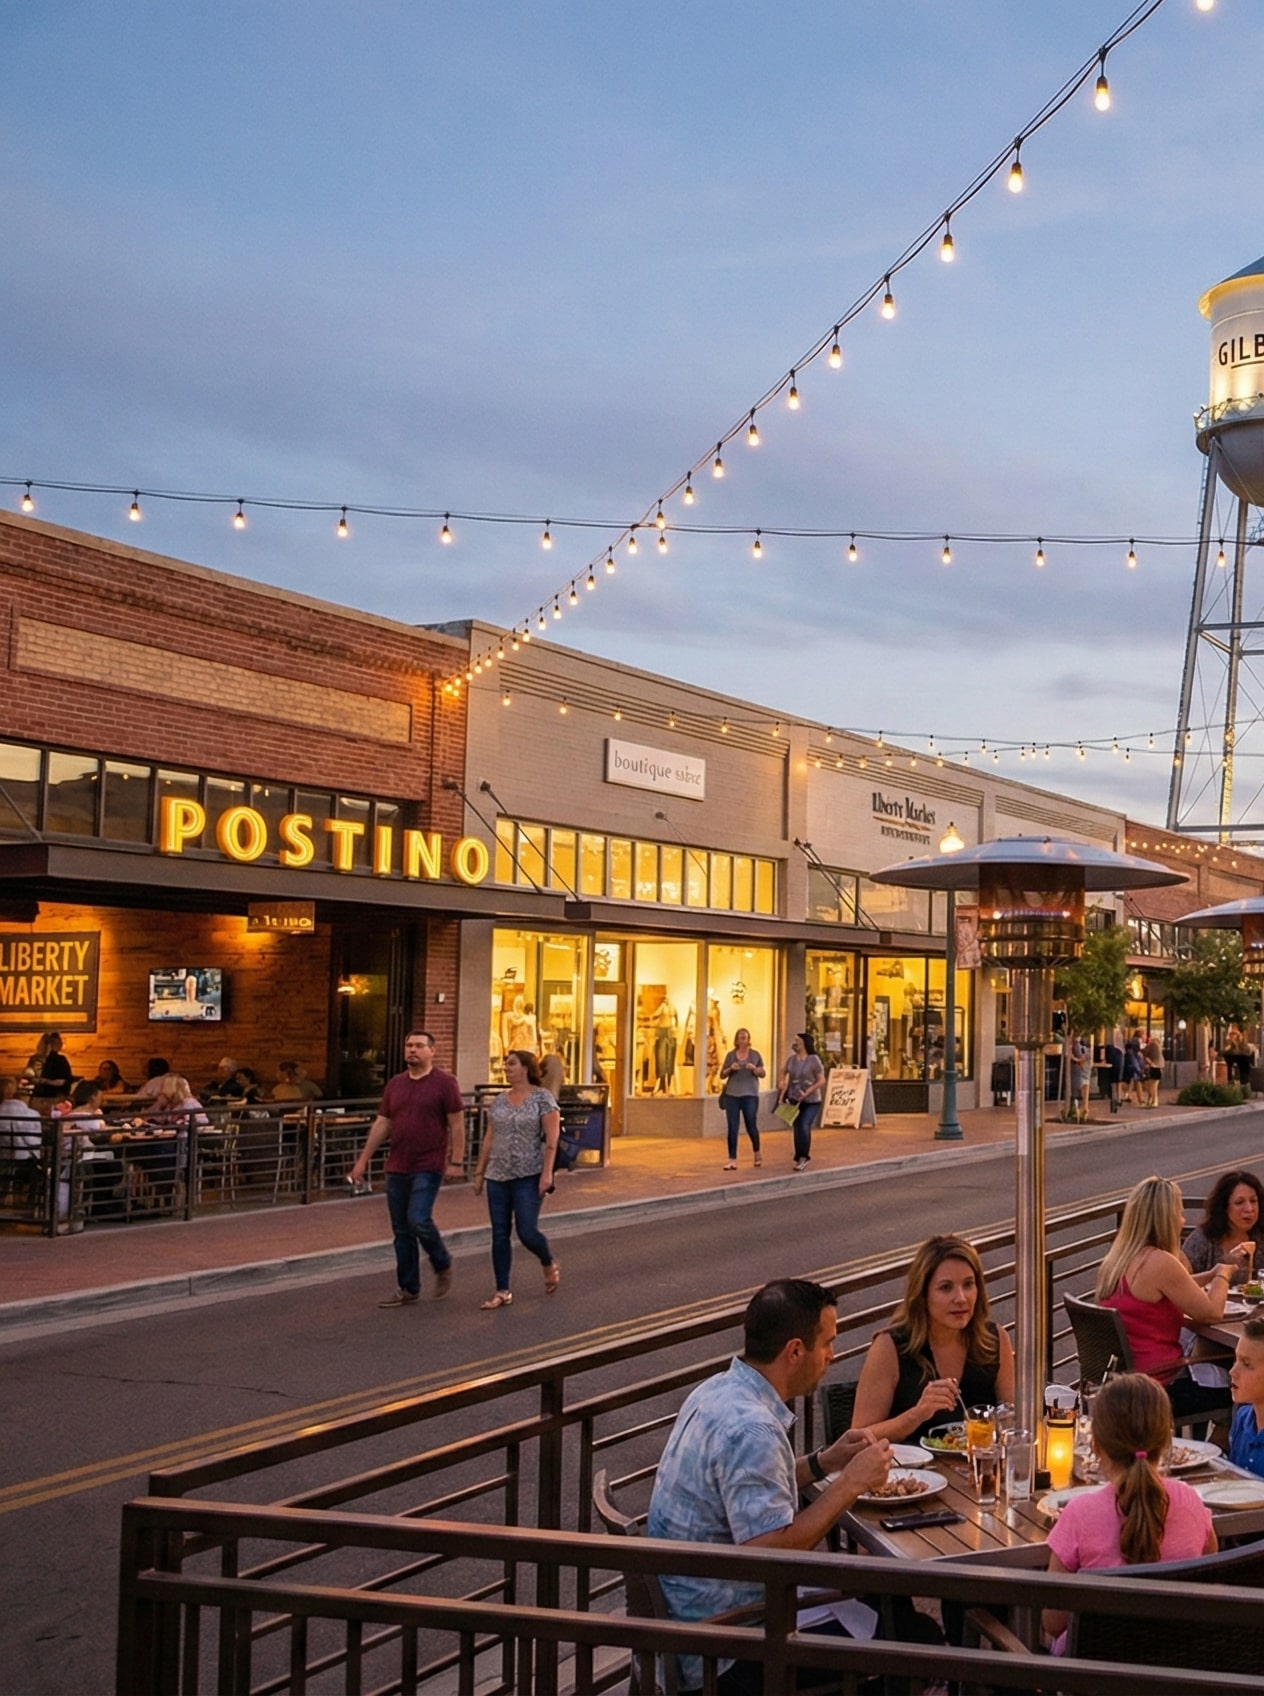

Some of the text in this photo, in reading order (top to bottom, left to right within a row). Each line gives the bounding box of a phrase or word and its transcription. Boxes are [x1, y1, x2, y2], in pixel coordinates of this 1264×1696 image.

[614, 749, 672, 782] boutique
[161, 796, 490, 886] POSTINO
[0, 940, 90, 971] LIBERTY
[0, 974, 89, 1006] MARKET
